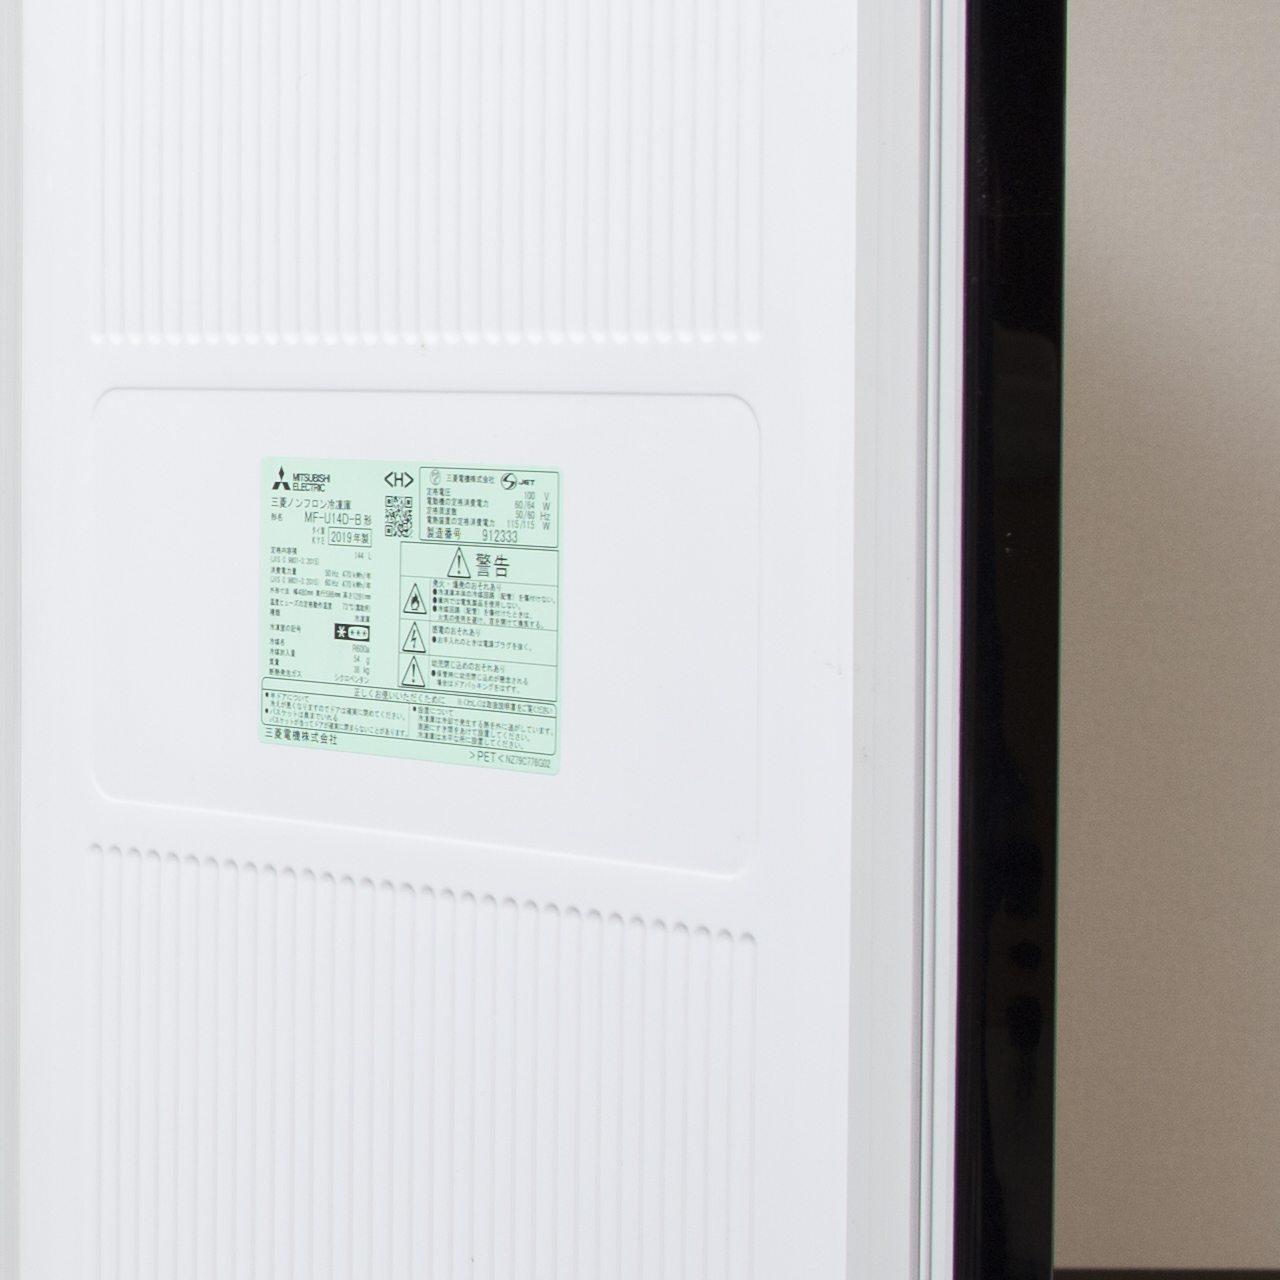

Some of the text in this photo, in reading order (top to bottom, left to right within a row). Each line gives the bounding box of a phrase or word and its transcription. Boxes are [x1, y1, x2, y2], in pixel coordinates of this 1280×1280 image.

[293, 473, 331, 483] MITSUBISHI
[447, 474, 495, 484] 三菱電機株式会社
[293, 483, 326, 492] ELECTRIC
[427, 488, 451, 497] 定格電圧
[525, 491, 535, 500] 100
[271, 497, 352, 510] 三菱ノンフロン冷凍庫
[542, 502, 551, 511] W
[540, 511, 550, 521] Hz
[542, 521, 550, 531] W
[312, 531, 370, 545] KYE 2019年製
[427, 527, 518, 543] 製造番号 912333
[476, 552, 510, 578] 警告
[265, 727, 338, 745] 三菱電機株式会社
